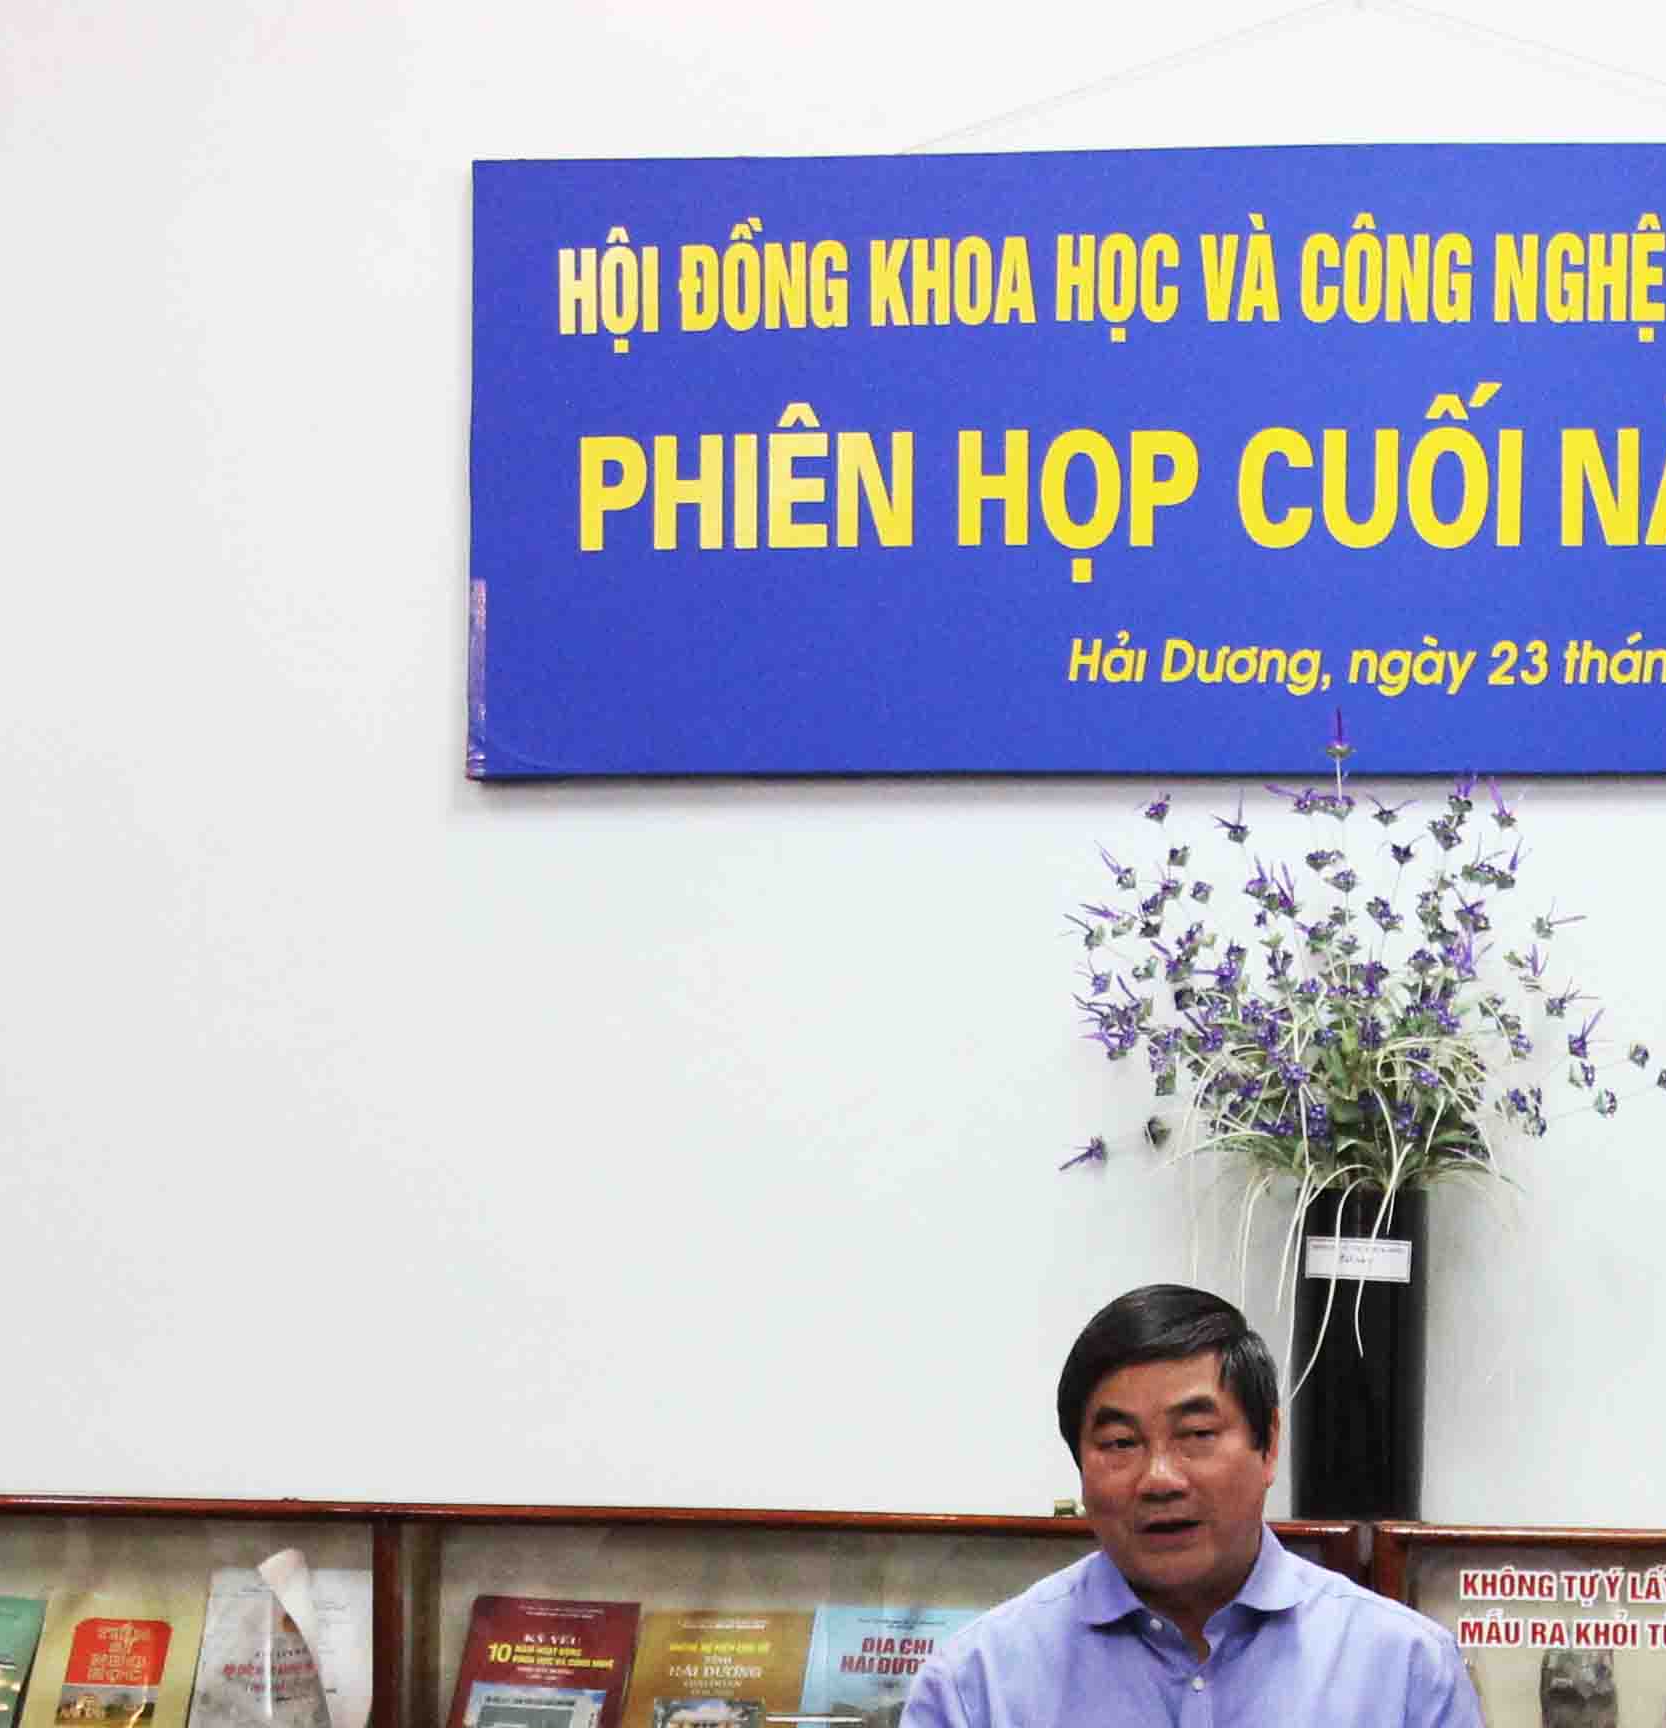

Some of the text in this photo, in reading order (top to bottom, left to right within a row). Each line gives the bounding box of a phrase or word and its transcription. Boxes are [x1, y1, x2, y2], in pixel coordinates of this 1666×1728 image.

[558, 226, 660, 354] HỘI
[678, 215, 849, 332] ĐỒNG
[870, 235, 1037, 326] KHOA
[1055, 232, 1180, 342] HỌC
[1200, 212, 1280, 322] VÀ
[1300, 212, 1473, 323] CÔNG
[1494, 212, 1666, 342] NGHỆ
[578, 402, 914, 552] PHIÊN
[957, 427, 1200, 584] HỌP
[1237, 381, 1524, 550] CUỐI
[1068, 630, 1149, 683] Hải
[1161, 638, 1331, 696] Dương,
[1348, 635, 1476, 697] ngày
[1489, 638, 1549, 686] 23
[1462, 1566, 1555, 1600] KHÔNG
[1564, 1570, 1600, 1607] TỰ
[1604, 1564, 1622, 1601] Ý
[488, 1642, 512, 1664] 10
[1459, 1612, 1522, 1646] MẪU
[1529, 1620, 1568, 1647] RA
[1574, 1612, 1639, 1650] KHỎI
